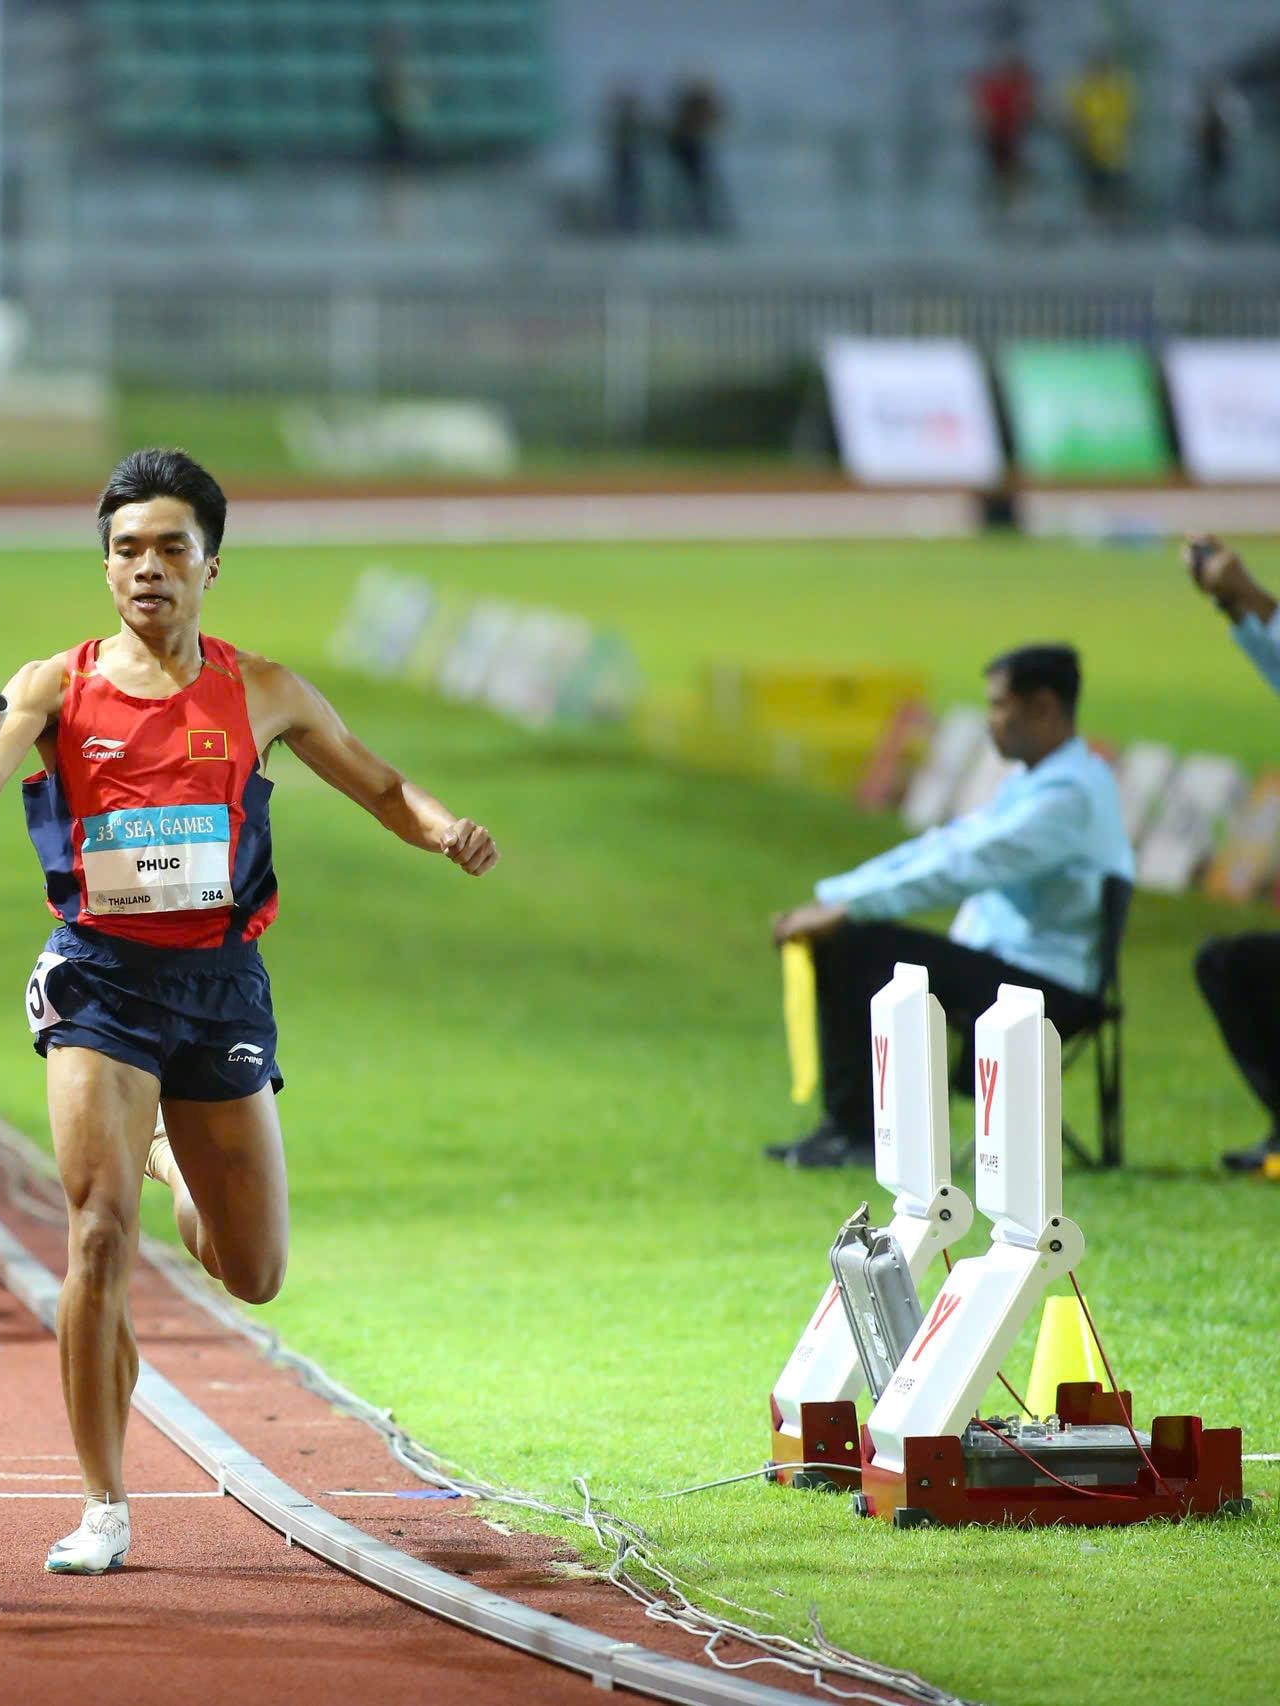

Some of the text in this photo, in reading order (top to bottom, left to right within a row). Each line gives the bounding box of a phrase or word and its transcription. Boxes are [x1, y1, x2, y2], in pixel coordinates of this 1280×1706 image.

[82, 751, 125, 759] LI-NING
[124, 820, 155, 839] SEA
[160, 816, 214, 836] GAMES
[136, 857, 181, 873] PHUC
[108, 895, 150, 906] THAILAND
[201, 889, 224, 901] 284
[227, 1053, 264, 1066] LI-NING
